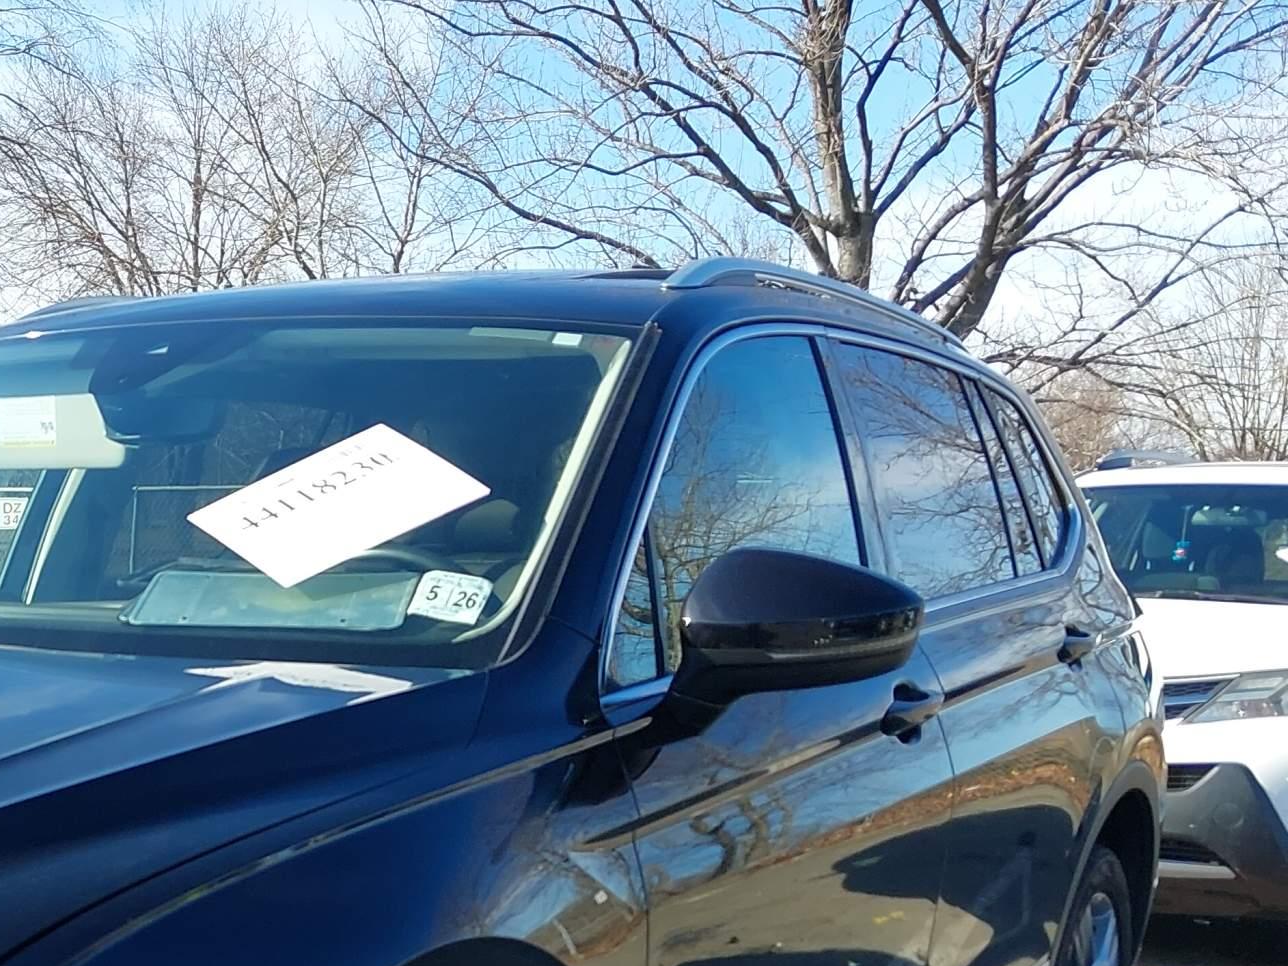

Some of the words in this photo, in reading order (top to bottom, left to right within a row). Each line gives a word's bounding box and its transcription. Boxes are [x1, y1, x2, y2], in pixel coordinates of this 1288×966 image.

[242, 453, 394, 530] 44118230
[3, 502, 22, 514] DZ
[425, 585, 441, 601] 5
[452, 591, 479, 609] 26
